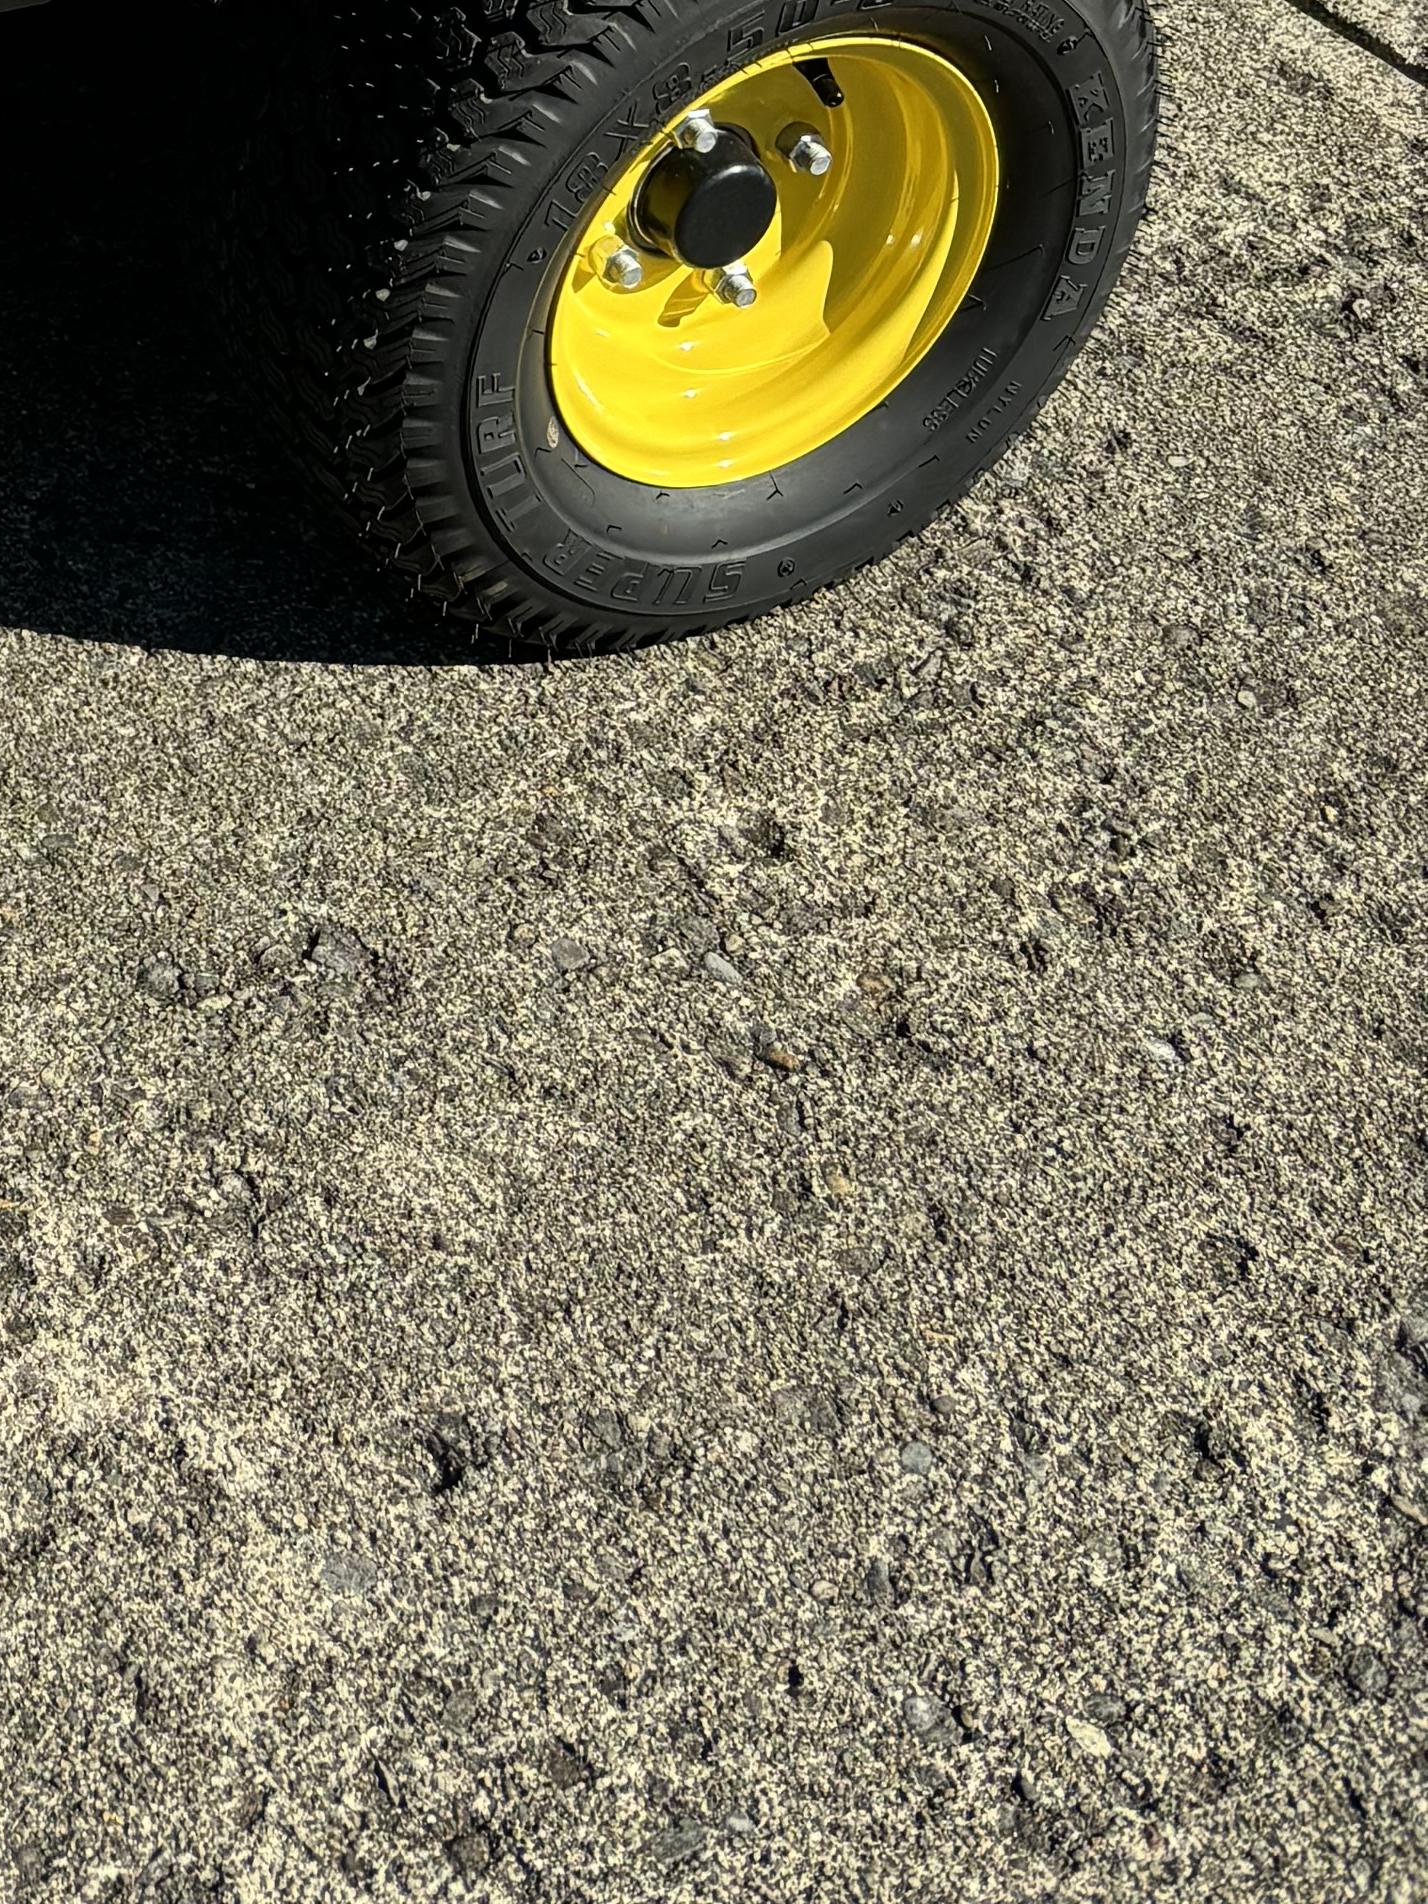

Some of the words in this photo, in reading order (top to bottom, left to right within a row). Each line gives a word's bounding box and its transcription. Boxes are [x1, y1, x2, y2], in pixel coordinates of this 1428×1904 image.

[1041, 70, 1115, 321] KENDA
[475, 372, 544, 534] TURF
[967, 380, 1023, 445] NYLON
[542, 528, 747, 607] SUPER
